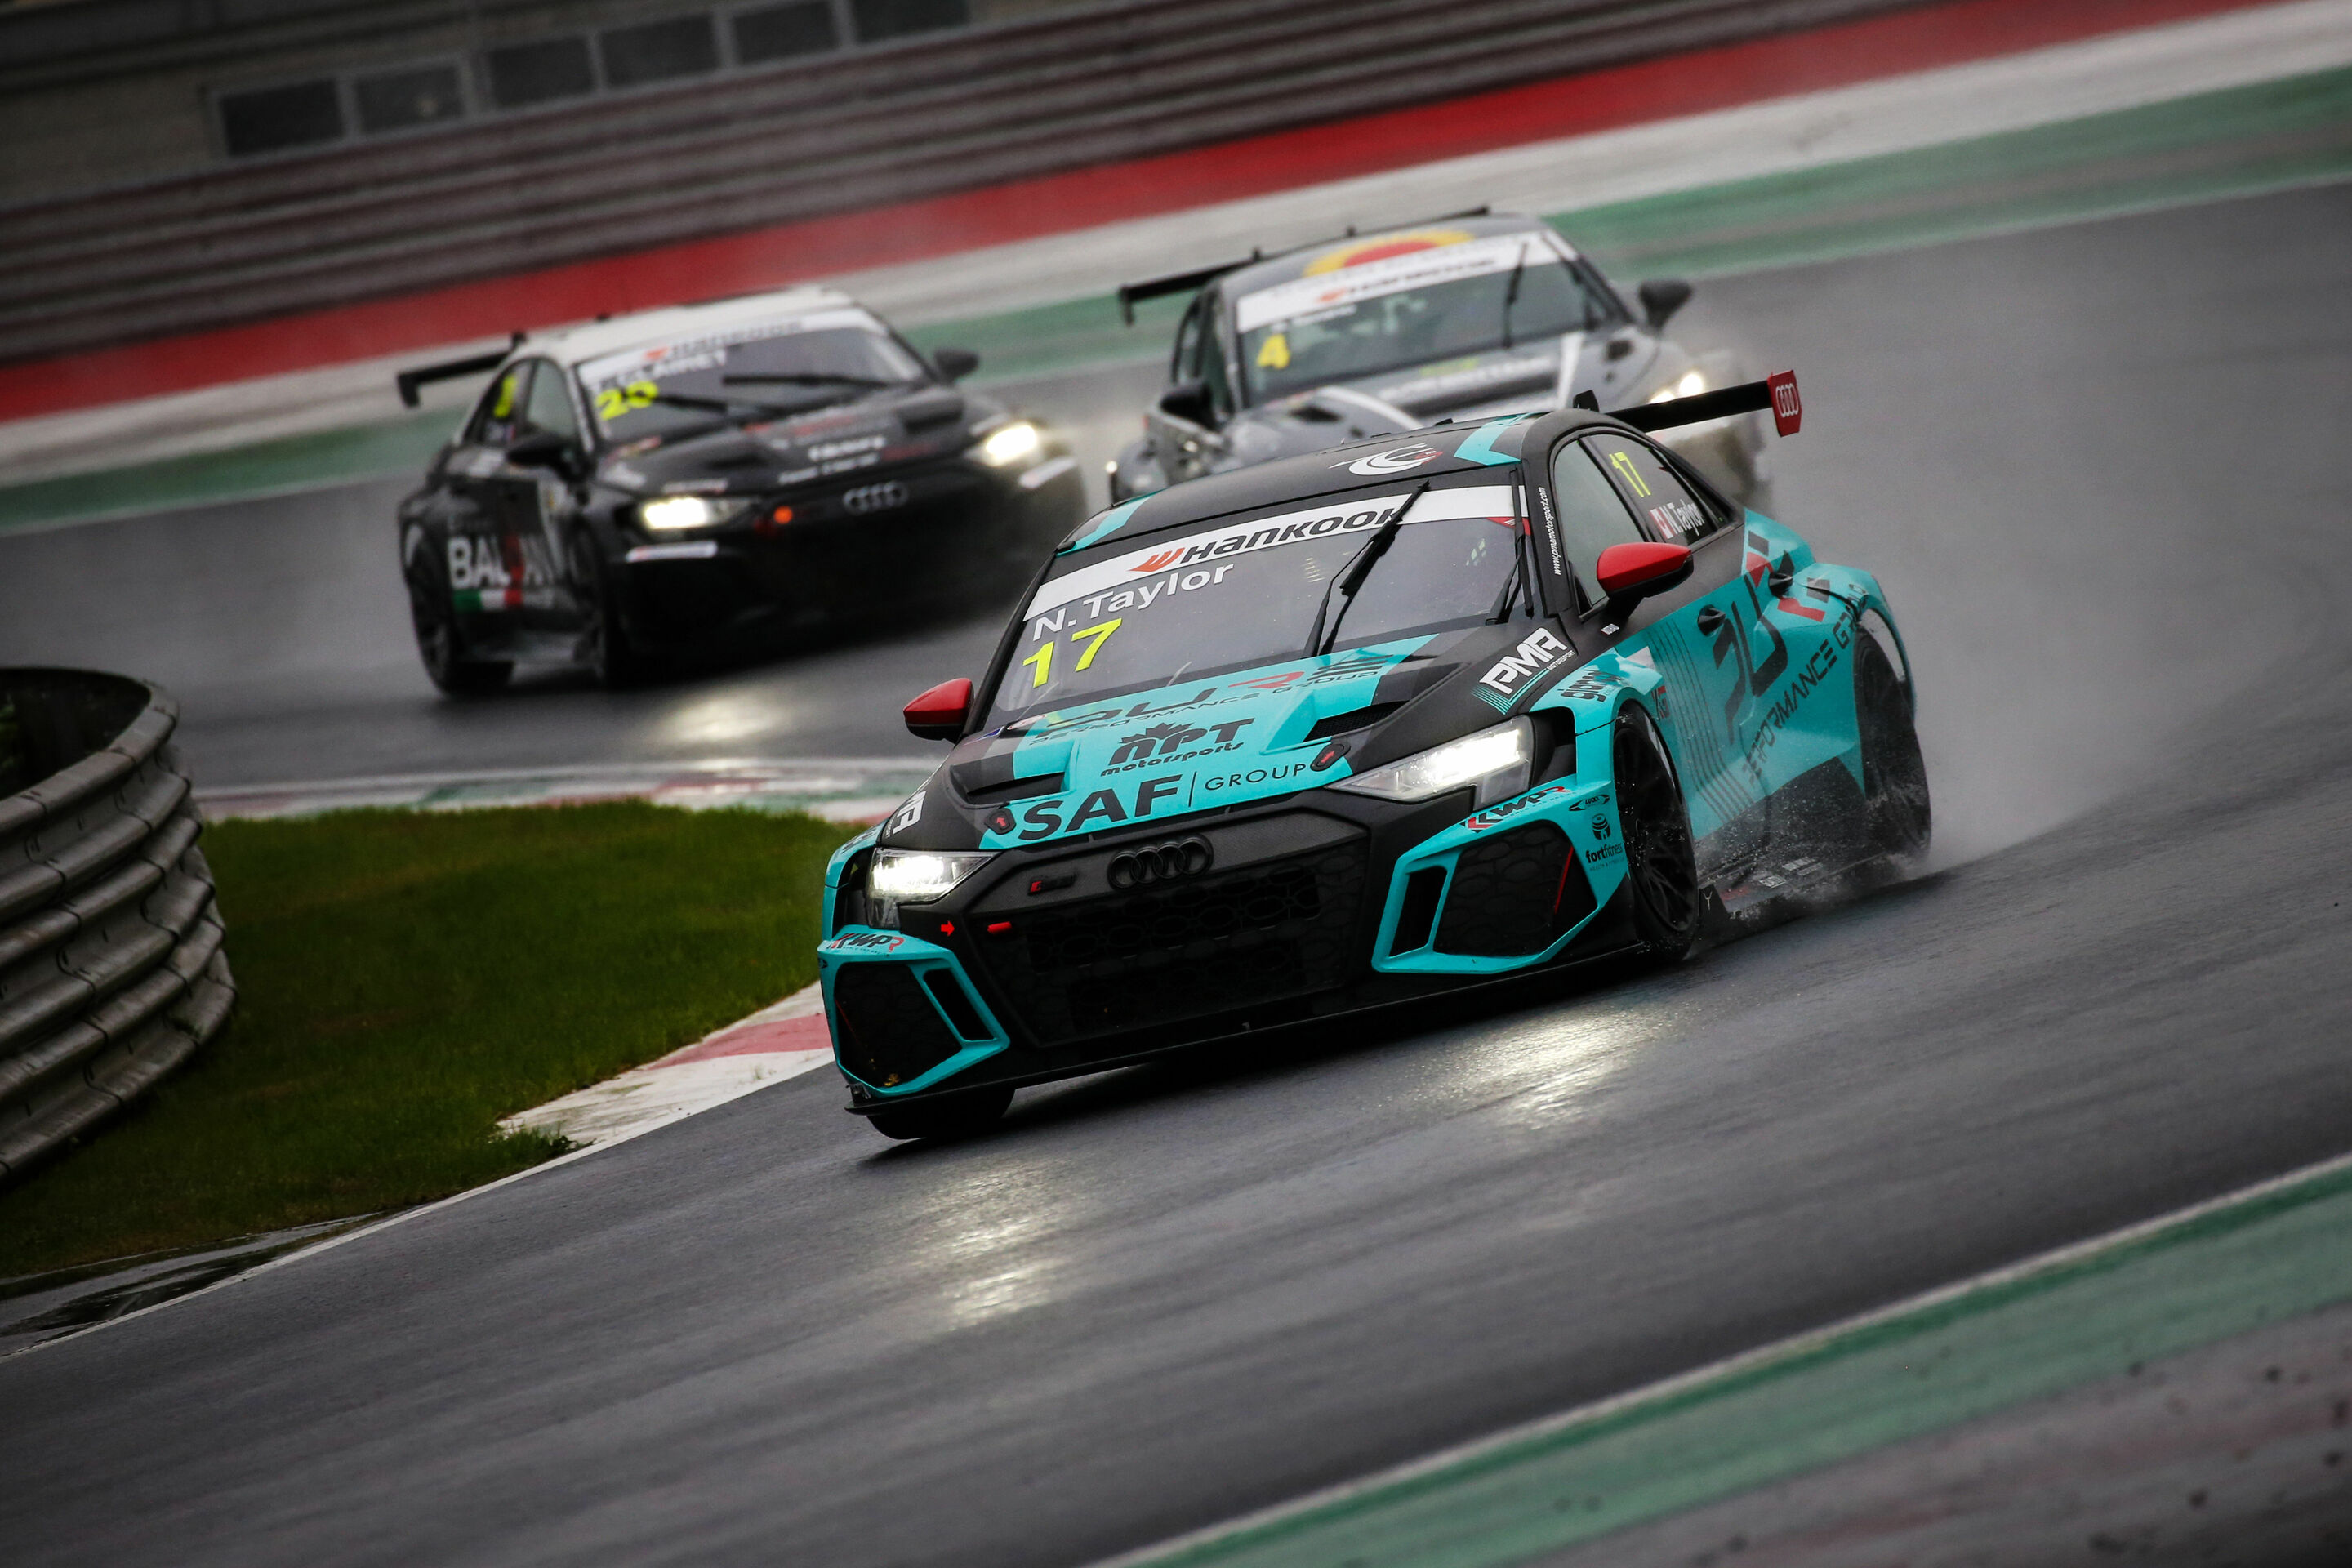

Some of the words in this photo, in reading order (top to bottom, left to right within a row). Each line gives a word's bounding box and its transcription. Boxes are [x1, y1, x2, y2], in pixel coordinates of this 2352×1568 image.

[1609, 451, 1651, 497] 17
[1538, 487, 1561, 576] www.pmamotorsport.com
[1022, 617, 1122, 688] 17
[1100, 742, 1244, 777] motorsports
[1018, 773, 1182, 840] SAF
[1205, 763, 1307, 792] GROUP
